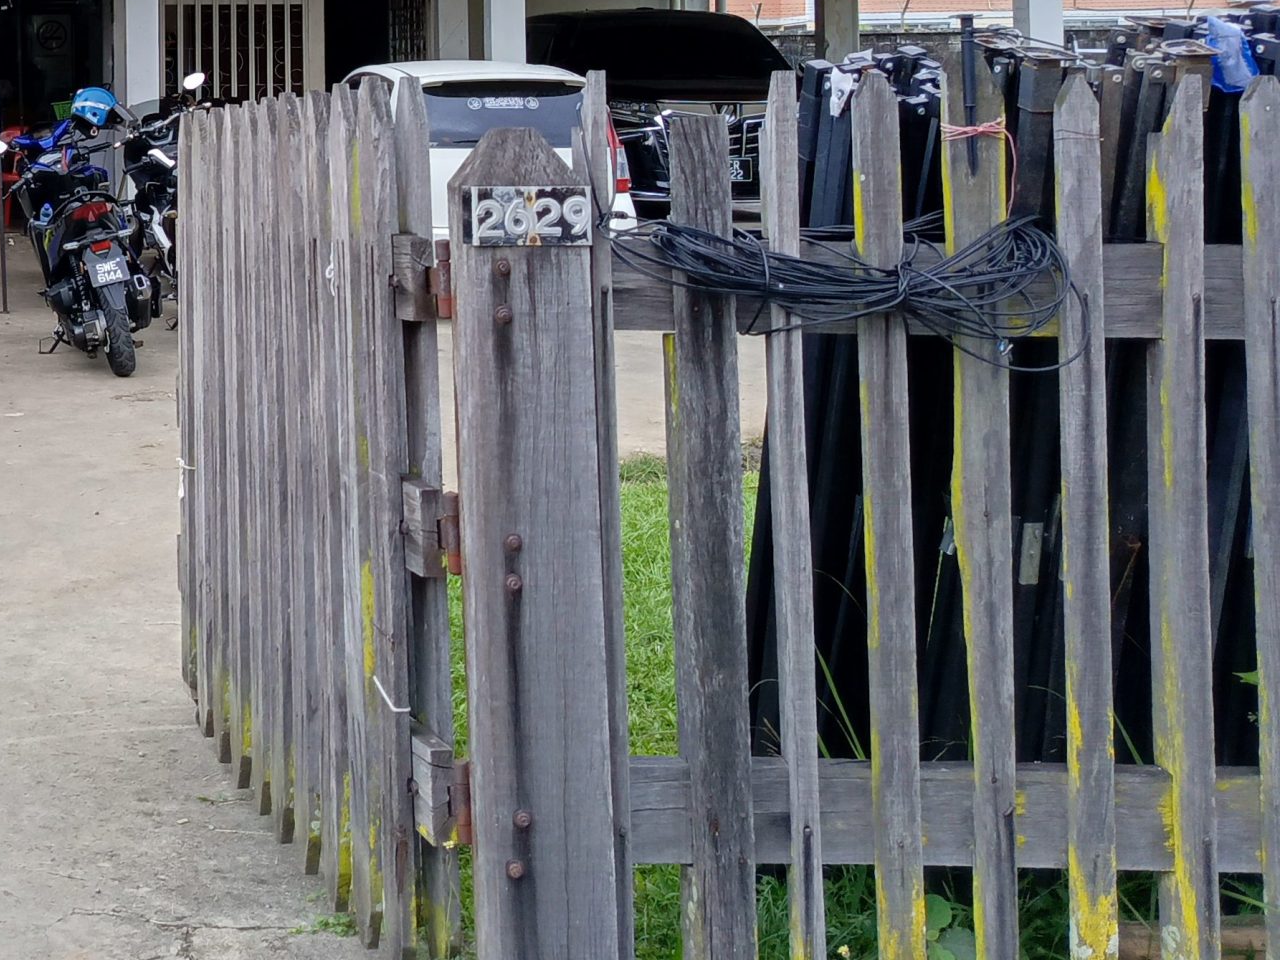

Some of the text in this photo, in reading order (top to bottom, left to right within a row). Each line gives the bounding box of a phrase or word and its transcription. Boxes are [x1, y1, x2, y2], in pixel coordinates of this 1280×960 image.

[476, 195, 590, 238] 2629
[95, 260, 119, 273] SWE
[97, 269, 123, 283] 6144
